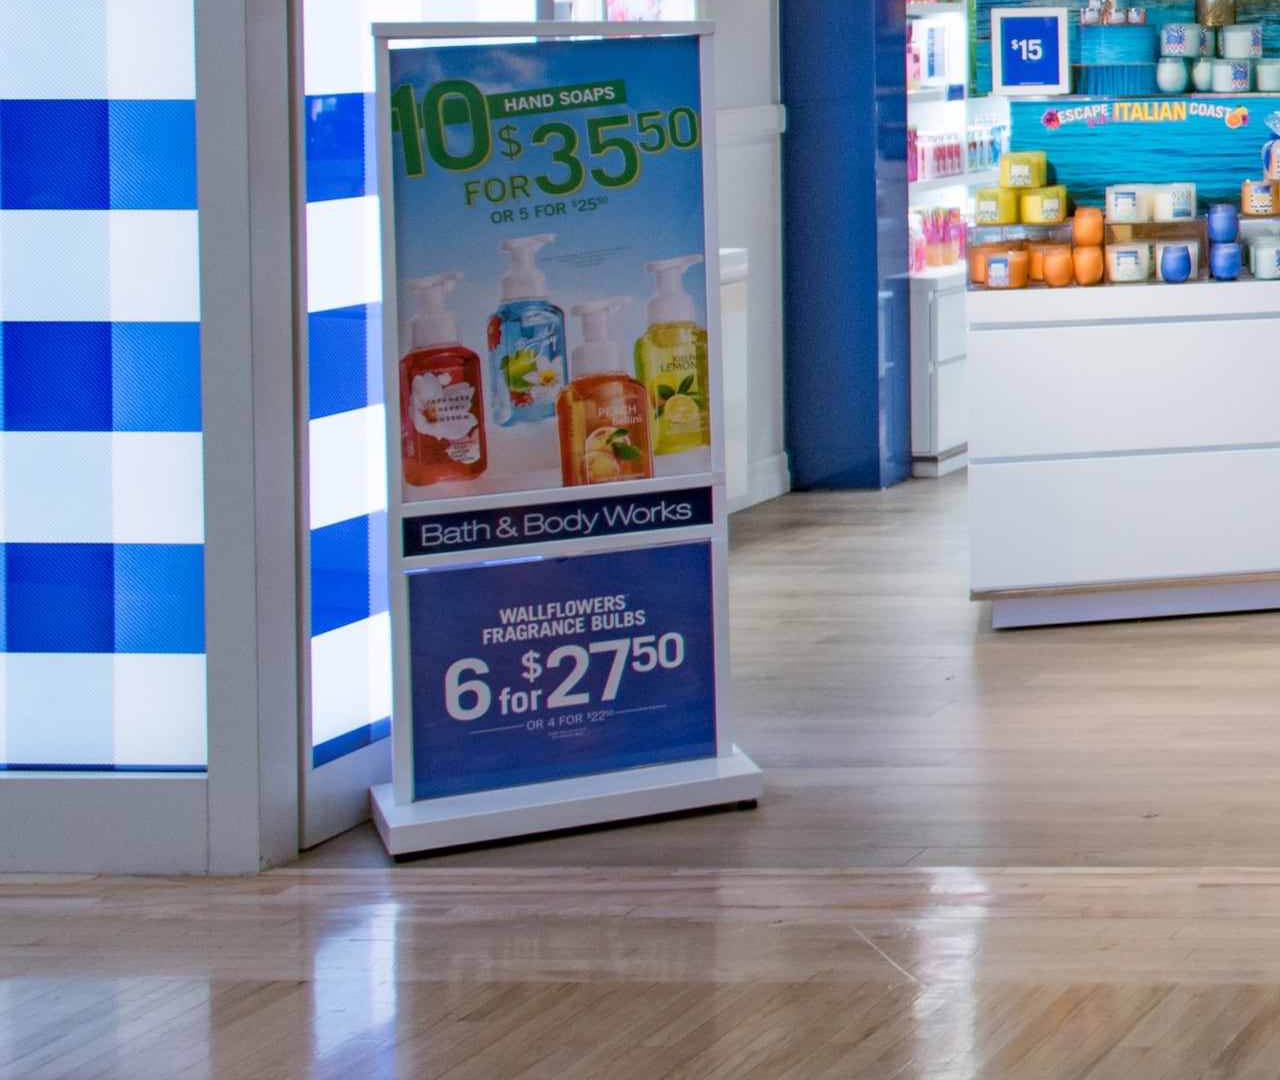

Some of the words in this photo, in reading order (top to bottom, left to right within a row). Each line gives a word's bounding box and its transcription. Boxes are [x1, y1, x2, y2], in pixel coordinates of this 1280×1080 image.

[1011, 39, 1043, 61] $15
[504, 93, 554, 113] HAND
[559, 86, 615, 106] SOAPS
[1058, 104, 1109, 124] ESCAPE
[1112, 101, 1187, 122] ITALIAN
[1189, 103, 1233, 119] COAST
[391, 79, 493, 178] 10
[464, 174, 532, 208] FOR
[490, 209, 514, 224] OR
[518, 207, 530, 221] 5
[534, 201, 567, 218] FOR
[421, 519, 491, 547] Bath
[496, 516, 518, 538] &
[524, 508, 599, 535] Body
[603, 501, 693, 527] Works
[499, 594, 627, 624] WALLFLOWERS
[482, 616, 585, 645] FRAGRANCE
[591, 610, 646, 632] BULBS
[444, 657, 492, 721] 6
[499, 686, 542, 715] for
[526, 720, 544, 731] OR
[547, 717, 555, 727] 4
[559, 713, 583, 726] FOR
